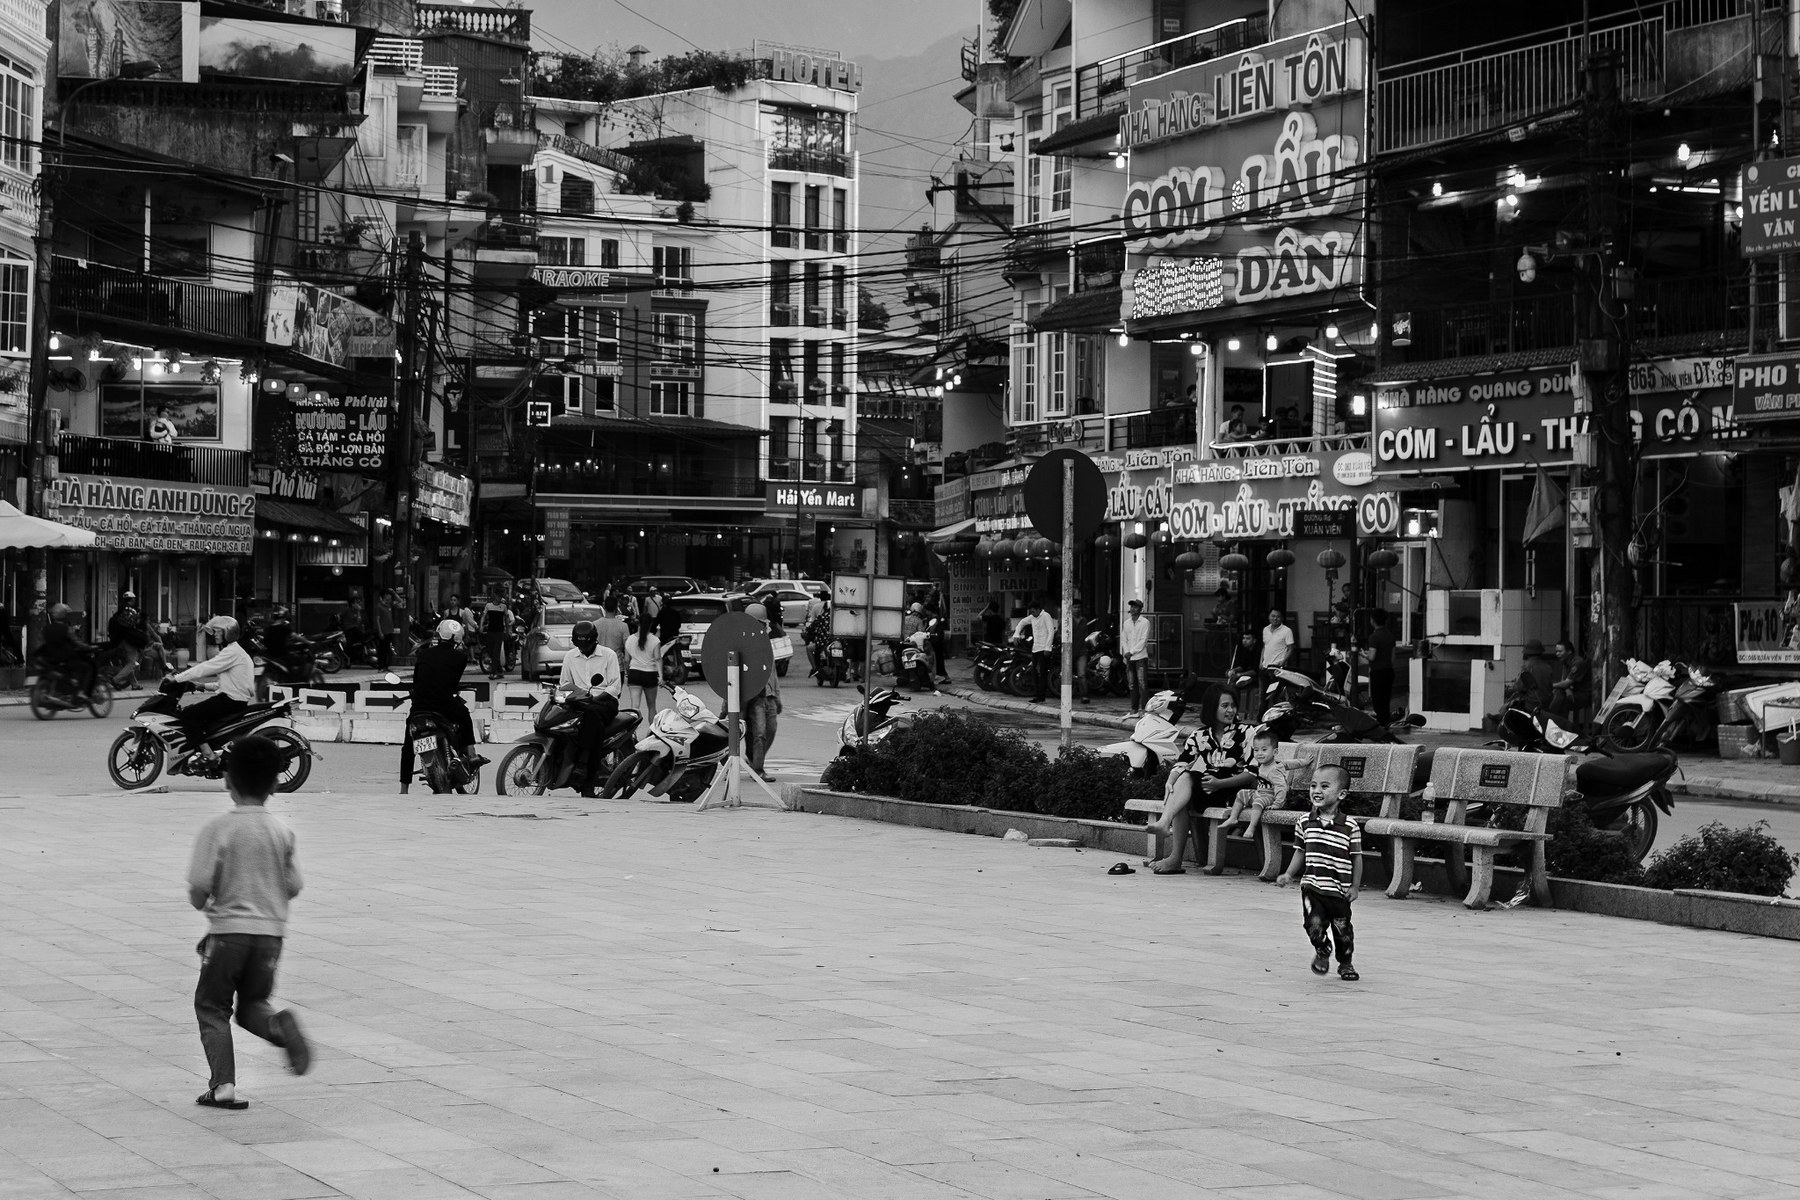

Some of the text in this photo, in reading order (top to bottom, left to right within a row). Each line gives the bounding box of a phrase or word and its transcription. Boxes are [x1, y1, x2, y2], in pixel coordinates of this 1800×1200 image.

[772, 49, 863, 92] HOTEL
[1119, 101, 1151, 148] NHÀ
[1214, 55, 1276, 122] LIÊN
[1285, 34, 1350, 104] TÔN
[1122, 112, 1347, 252] CƠM LẨU
[1749, 185, 1783, 214] YẾN
[1763, 217, 1795, 238] VĂN
[532, 268, 610, 288] ARAOKE
[1235, 227, 1345, 303] DÂN
[1739, 364, 1787, 388] PHO
[1378, 387, 1410, 408] NHÀ
[1416, 385, 1462, 405] HÀNG
[1469, 380, 1531, 401] QUANG
[360, 408, 387, 430] LẨU
[1378, 426, 1436, 461] CƠM
[1461, 403, 1515, 456] LẨU
[349, 431, 364, 442] CÁ
[1126, 450, 1160, 470] Liên
[1161, 447, 1192, 467] Tôn
[1174, 464, 1199, 483] NHÀ
[1243, 459, 1281, 478] Liên
[1283, 456, 1317, 475] Tôn
[52, 476, 255, 517] HÀ HÀNG ANH DŨNG 2
[272, 469, 296, 498] Phố
[776, 488, 856, 507] Hải Yến Mart
[1110, 471, 1137, 519] LẨU
[1144, 477, 1164, 518] CÁ
[100, 514, 114, 532] CÁ
[140, 517, 155, 533] CÁ
[1169, 499, 1212, 538] CƠM
[1222, 483, 1266, 537] LẨU
[1303, 522, 1342, 535] XUÂN VIÊN
[188, 540, 205, 551] RAU
[228, 541, 239, 552] SA
[1764, 609, 1778, 642] 10
